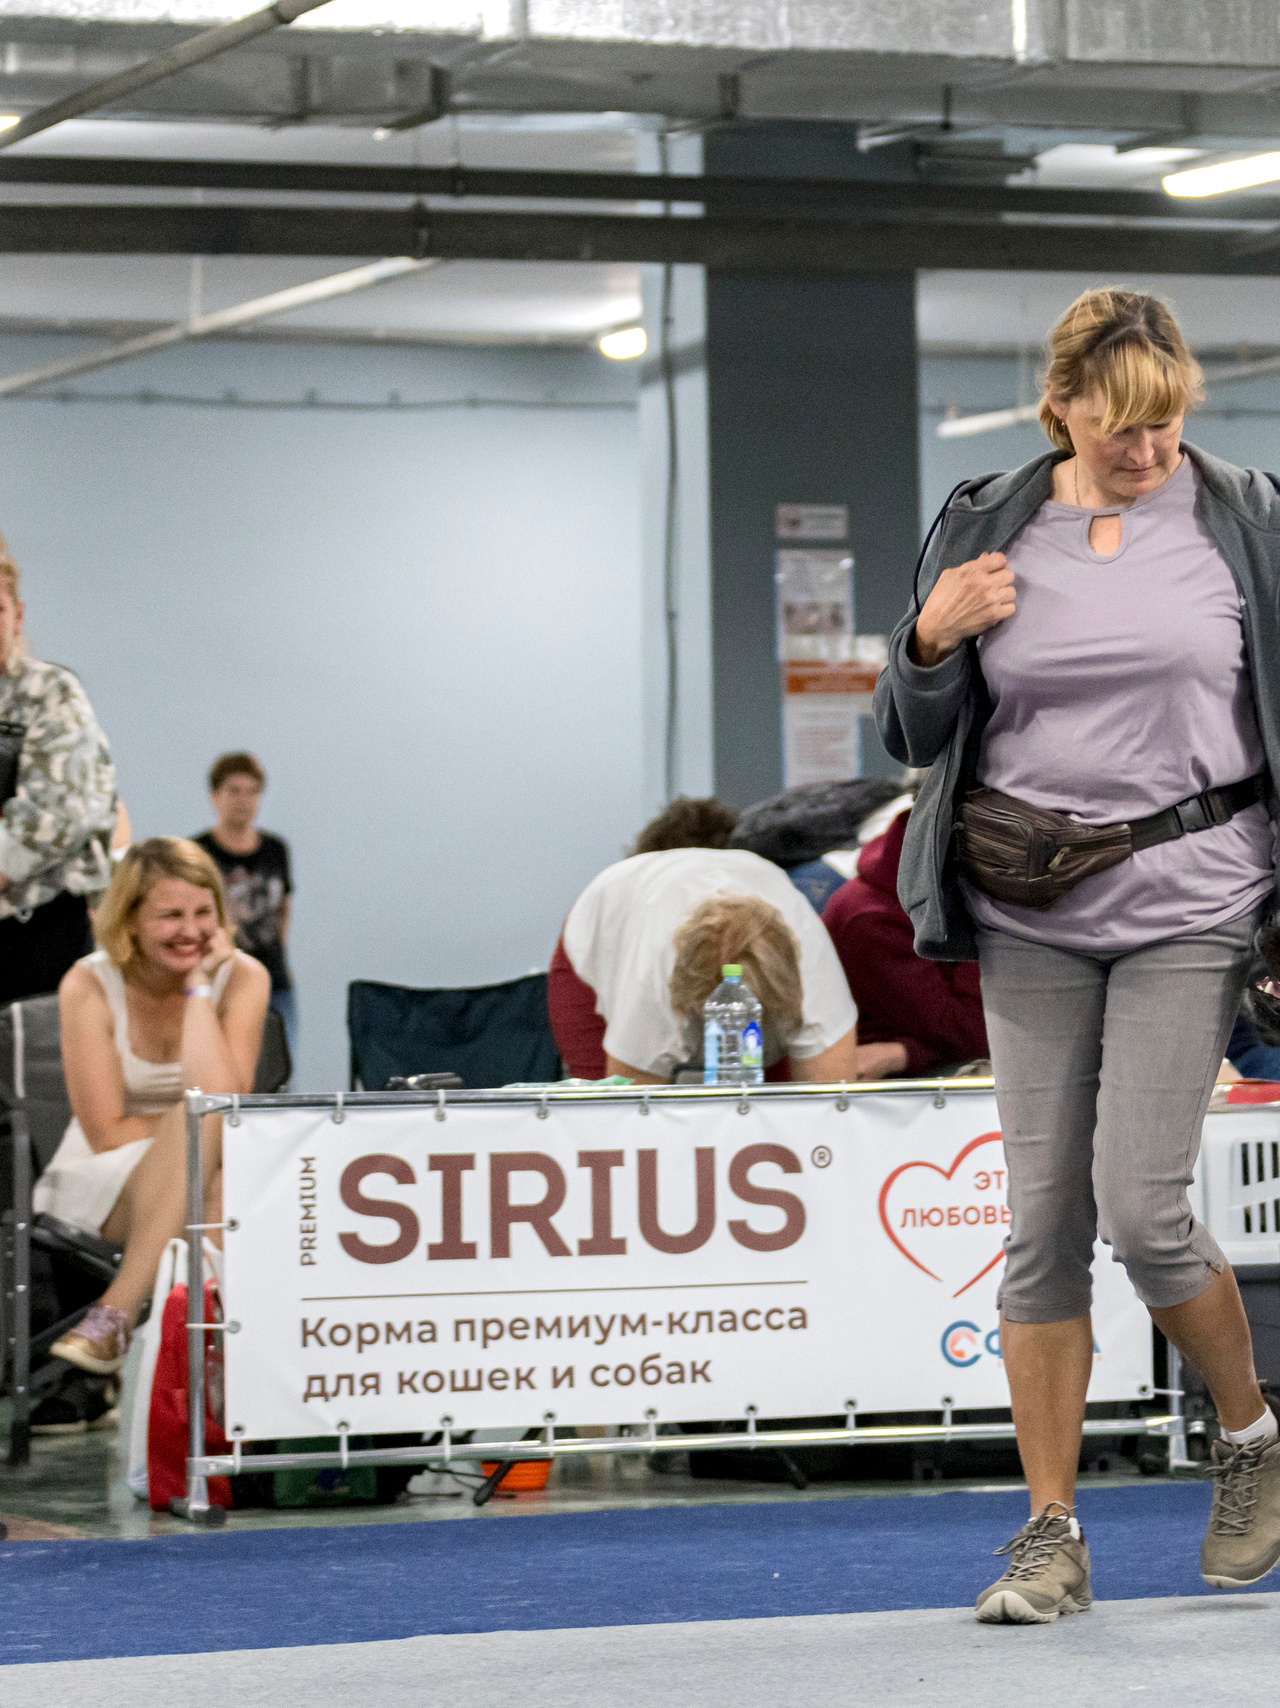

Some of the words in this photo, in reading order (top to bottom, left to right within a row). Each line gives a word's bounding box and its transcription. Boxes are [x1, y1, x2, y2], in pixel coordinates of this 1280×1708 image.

[974, 1170, 1008, 1191] ЭТ
[299, 1156, 317, 1267] PREMIUM
[900, 1204, 1012, 1229] ЛЮБОВЬ
[301, 1317, 438, 1354] Корма
[453, 1306, 809, 1350] премиум-класса
[302, 1371, 381, 1404] для
[397, 1366, 537, 1396] кошек
[551, 1365, 575, 1390] и
[589, 1353, 713, 1388] собак
